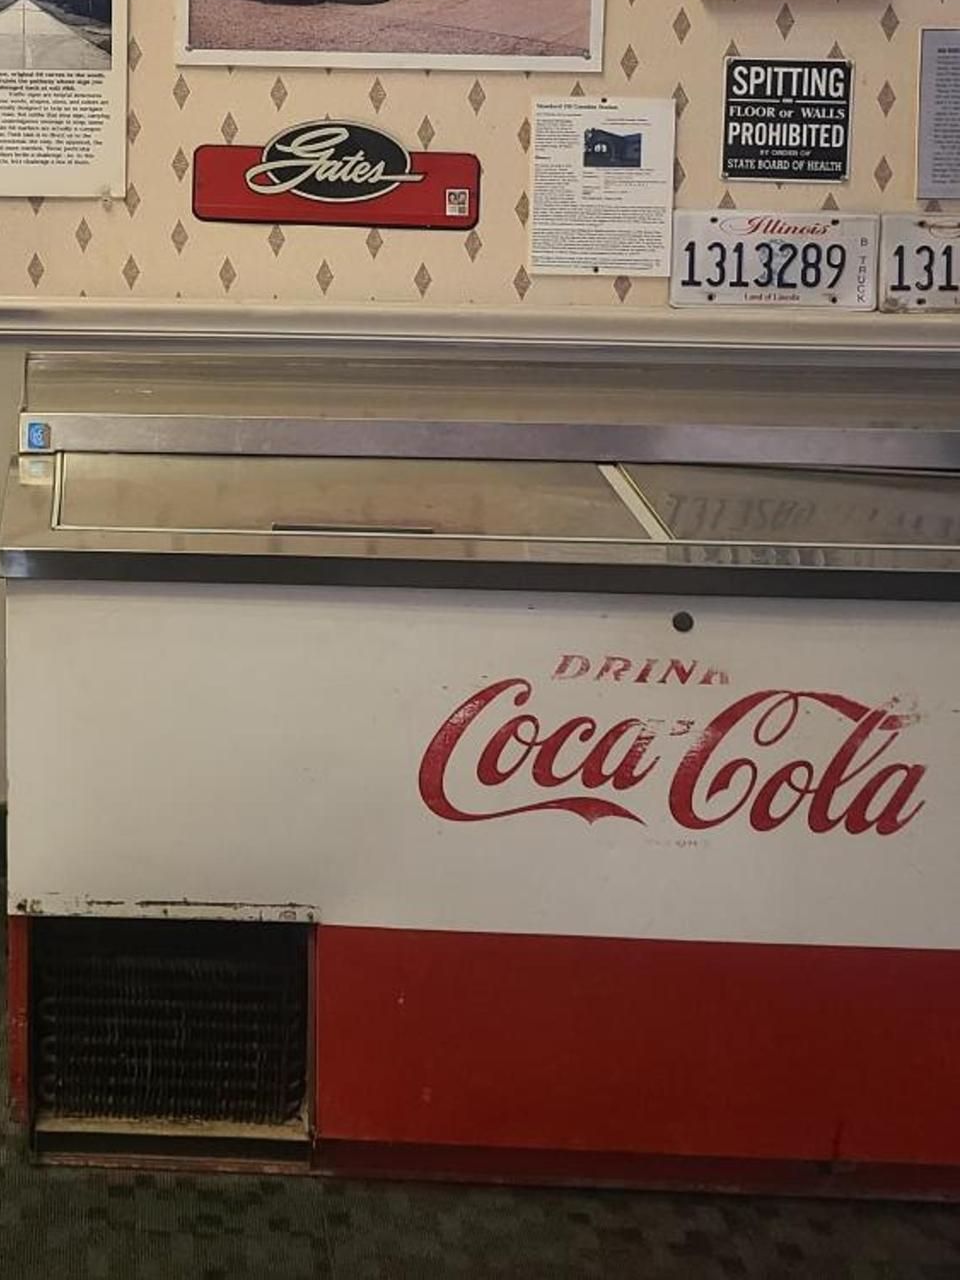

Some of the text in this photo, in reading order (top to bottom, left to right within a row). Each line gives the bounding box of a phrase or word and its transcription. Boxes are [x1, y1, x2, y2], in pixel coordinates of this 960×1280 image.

[732, 66, 845, 97] SPITTING
[729, 106, 846, 119] FLOOR or WALLS
[728, 122, 845, 148] PROHIBITED
[246, 127, 425, 194] Gates
[728, 158, 843, 172] STATE BOARD OF HEALTH
[746, 216, 832, 237] Illinois
[860, 237, 869, 247] B
[681, 241, 847, 290] 1313289
[856, 255, 868, 304] TRUCK
[744, 292, 763, 301] Land
[764, 292, 772, 300] of
